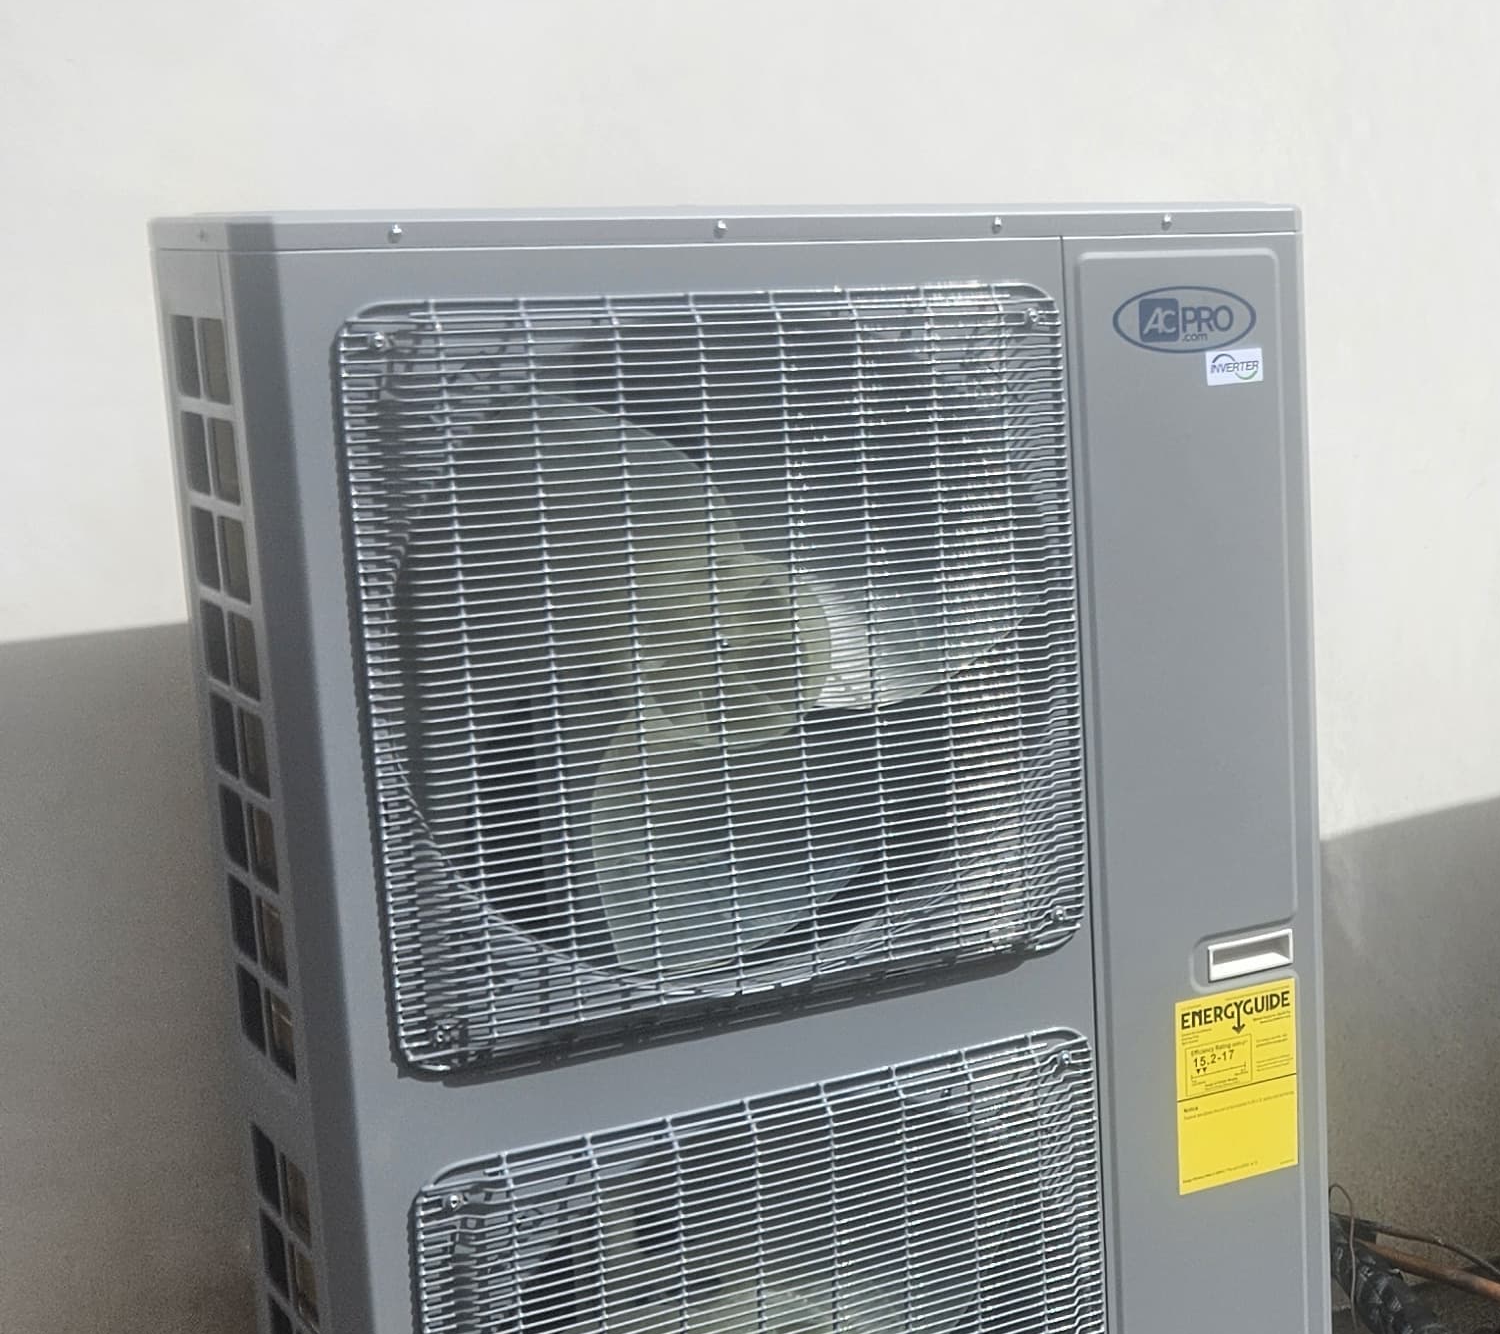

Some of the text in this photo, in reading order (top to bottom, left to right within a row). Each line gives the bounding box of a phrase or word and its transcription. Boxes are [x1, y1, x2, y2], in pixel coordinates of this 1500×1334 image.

[1210, 360, 1259, 374] INVERTER
[1181, 990, 1290, 1032] ENERGYGUIDE
[1193, 1049, 1235, 1069] 15.2-17
